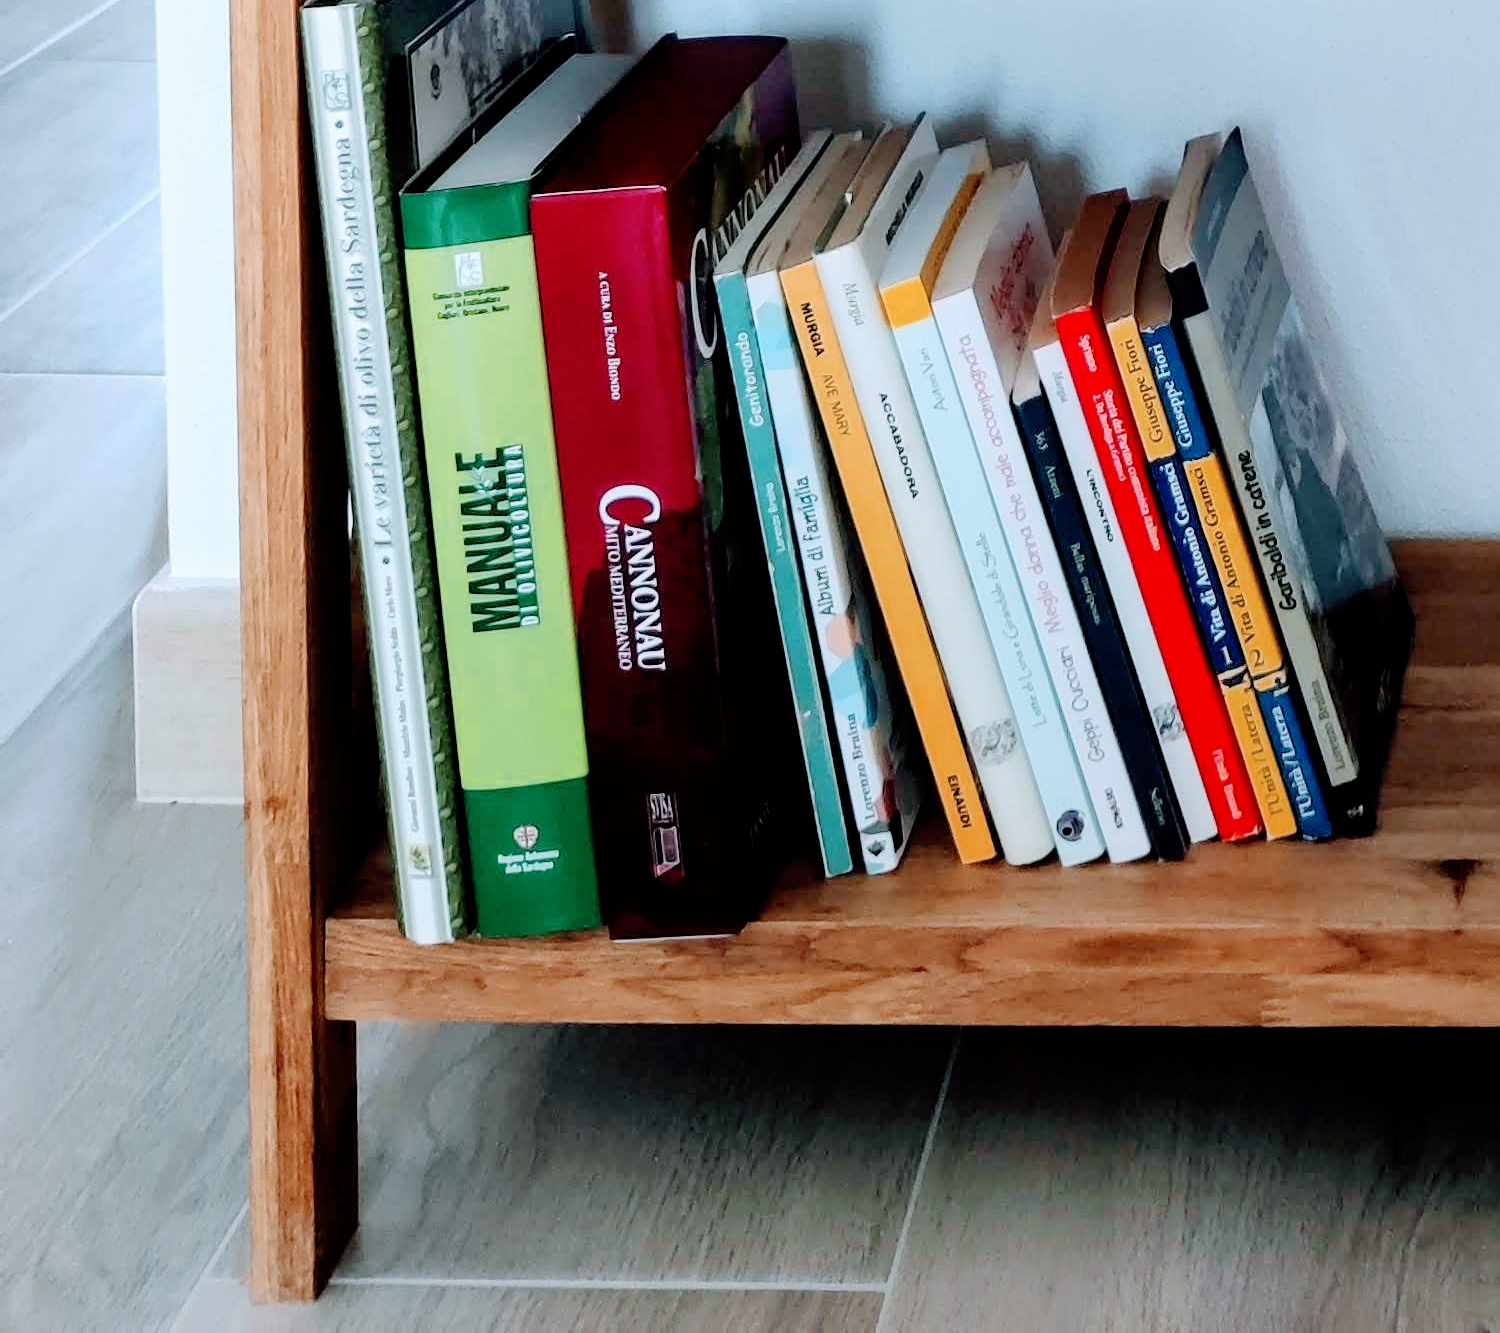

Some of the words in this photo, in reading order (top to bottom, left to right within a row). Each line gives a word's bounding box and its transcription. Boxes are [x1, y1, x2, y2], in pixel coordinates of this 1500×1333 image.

[332, 136, 363, 252] Sardegna
[345, 259, 368, 320] della
[352, 325, 372, 387] olivo
[800, 301, 825, 358] MURGIA
[606, 355, 622, 402] BIONDO
[735, 331, 766, 428] Genitorando
[822, 372, 840, 399] AVE
[958, 332, 1004, 448] accompagnata
[1136, 375, 1165, 444] Giuseppe
[826, 399, 852, 438] MARY
[1165, 379, 1194, 449] Giuseppe
[878, 392, 919, 501] ACCABADORA
[997, 451, 1017, 489] male
[793, 475, 820, 542] famiglia
[1086, 469, 1115, 543] L'INCONTRO
[1159, 460, 1191, 528] Gramsci
[1190, 466, 1222, 528] Gramsci
[1238, 450, 1266, 510] catene
[454, 446, 521, 633] MANUALE
[505, 445, 539, 598] OLIVICOLTURA
[1019, 524, 1046, 572] donna
[599, 483, 667, 672] CANNONAU
[1182, 527, 1210, 587] Antonio
[1213, 531, 1239, 588] Antonio
[1257, 528, 1297, 611] Garibaldi
[609, 565, 633, 671] MEDITERRANEO
[815, 564, 836, 617] Album
[1036, 579, 1064, 634] Meglio
[1060, 645, 1089, 712] Cucciari
[1081, 717, 1105, 763] Geppi
[859, 760, 878, 822] Lorenzo
[947, 774, 973, 830] EINAUDI
